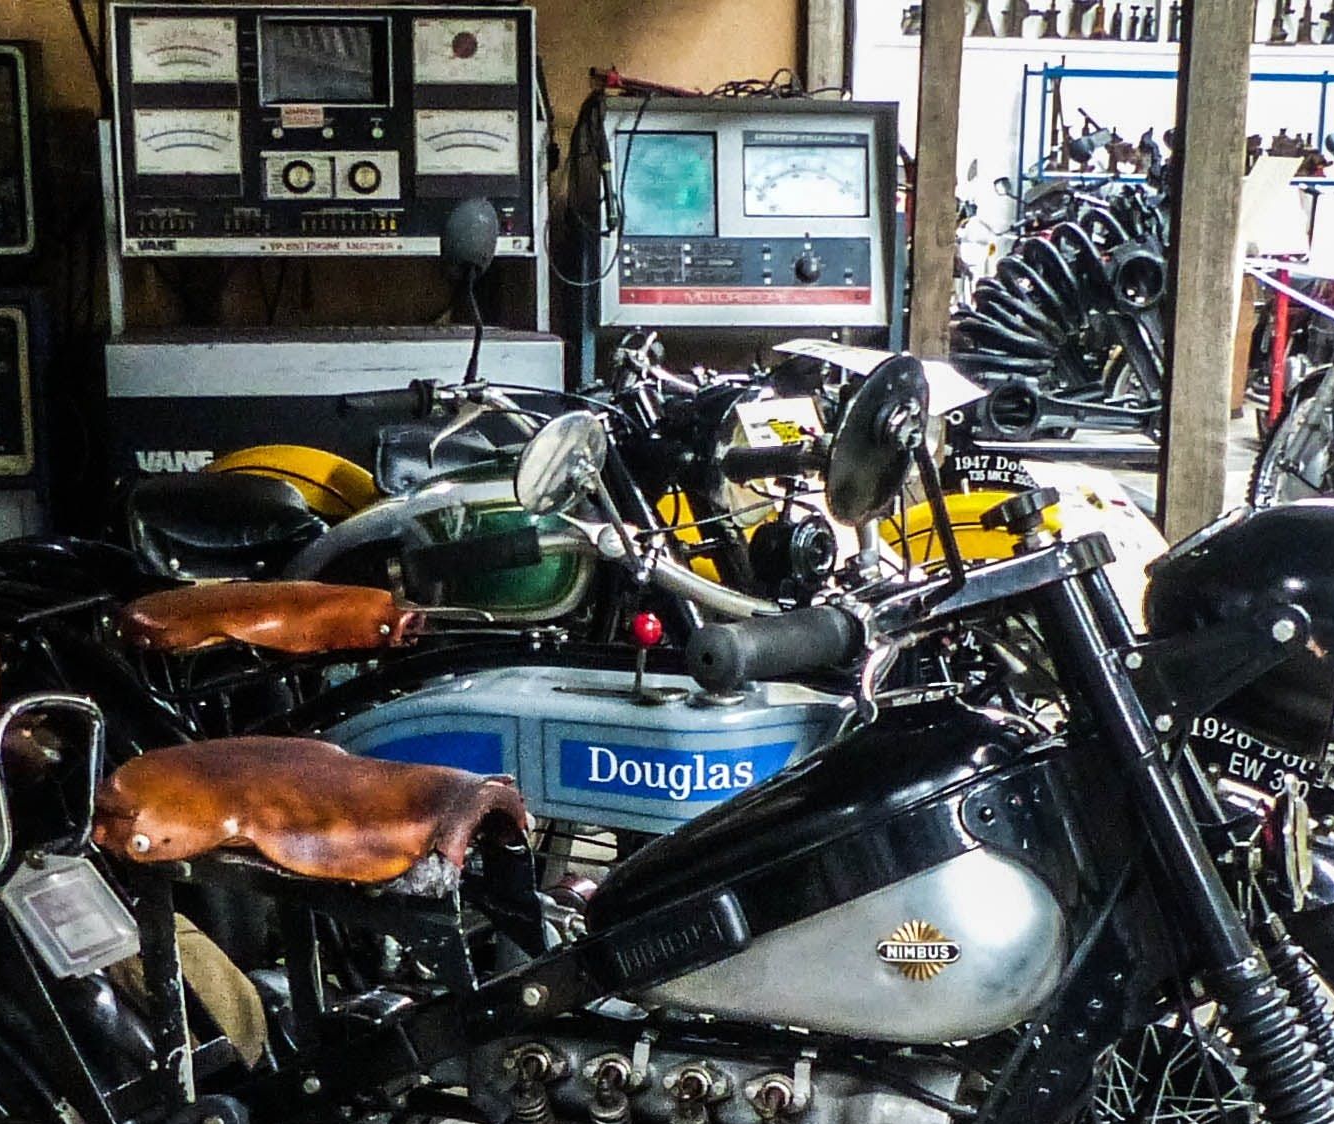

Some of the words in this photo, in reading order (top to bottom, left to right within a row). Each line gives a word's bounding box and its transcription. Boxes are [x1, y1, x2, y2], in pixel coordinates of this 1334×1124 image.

[955, 455, 990, 470] 1947
[588, 746, 754, 801] Douglas
[1228, 752, 1267, 782] EW
[1269, 769, 1310, 798] 30
[887, 945, 950, 959] NIMBUS
